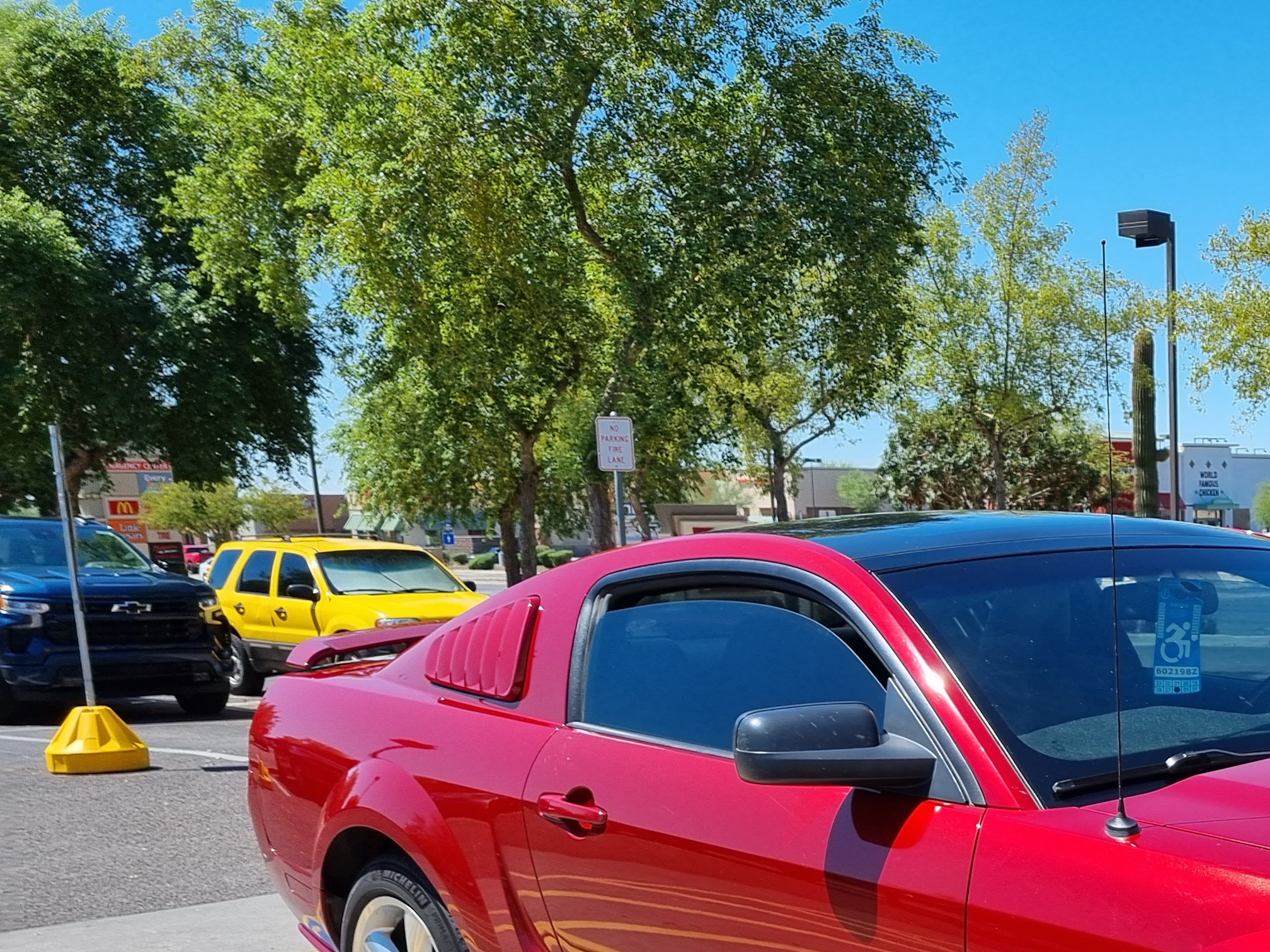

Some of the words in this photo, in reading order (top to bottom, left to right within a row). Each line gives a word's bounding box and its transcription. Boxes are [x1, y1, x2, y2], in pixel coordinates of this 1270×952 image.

[609, 424, 620, 432] NO
[608, 456, 625, 464] LANE
[1199, 471, 1218, 479] WORLD
[1198, 480, 1219, 488] FAMOUS
[1156, 667, 1198, 676] 602198Z
[383, 869, 428, 906] MICHELIN
